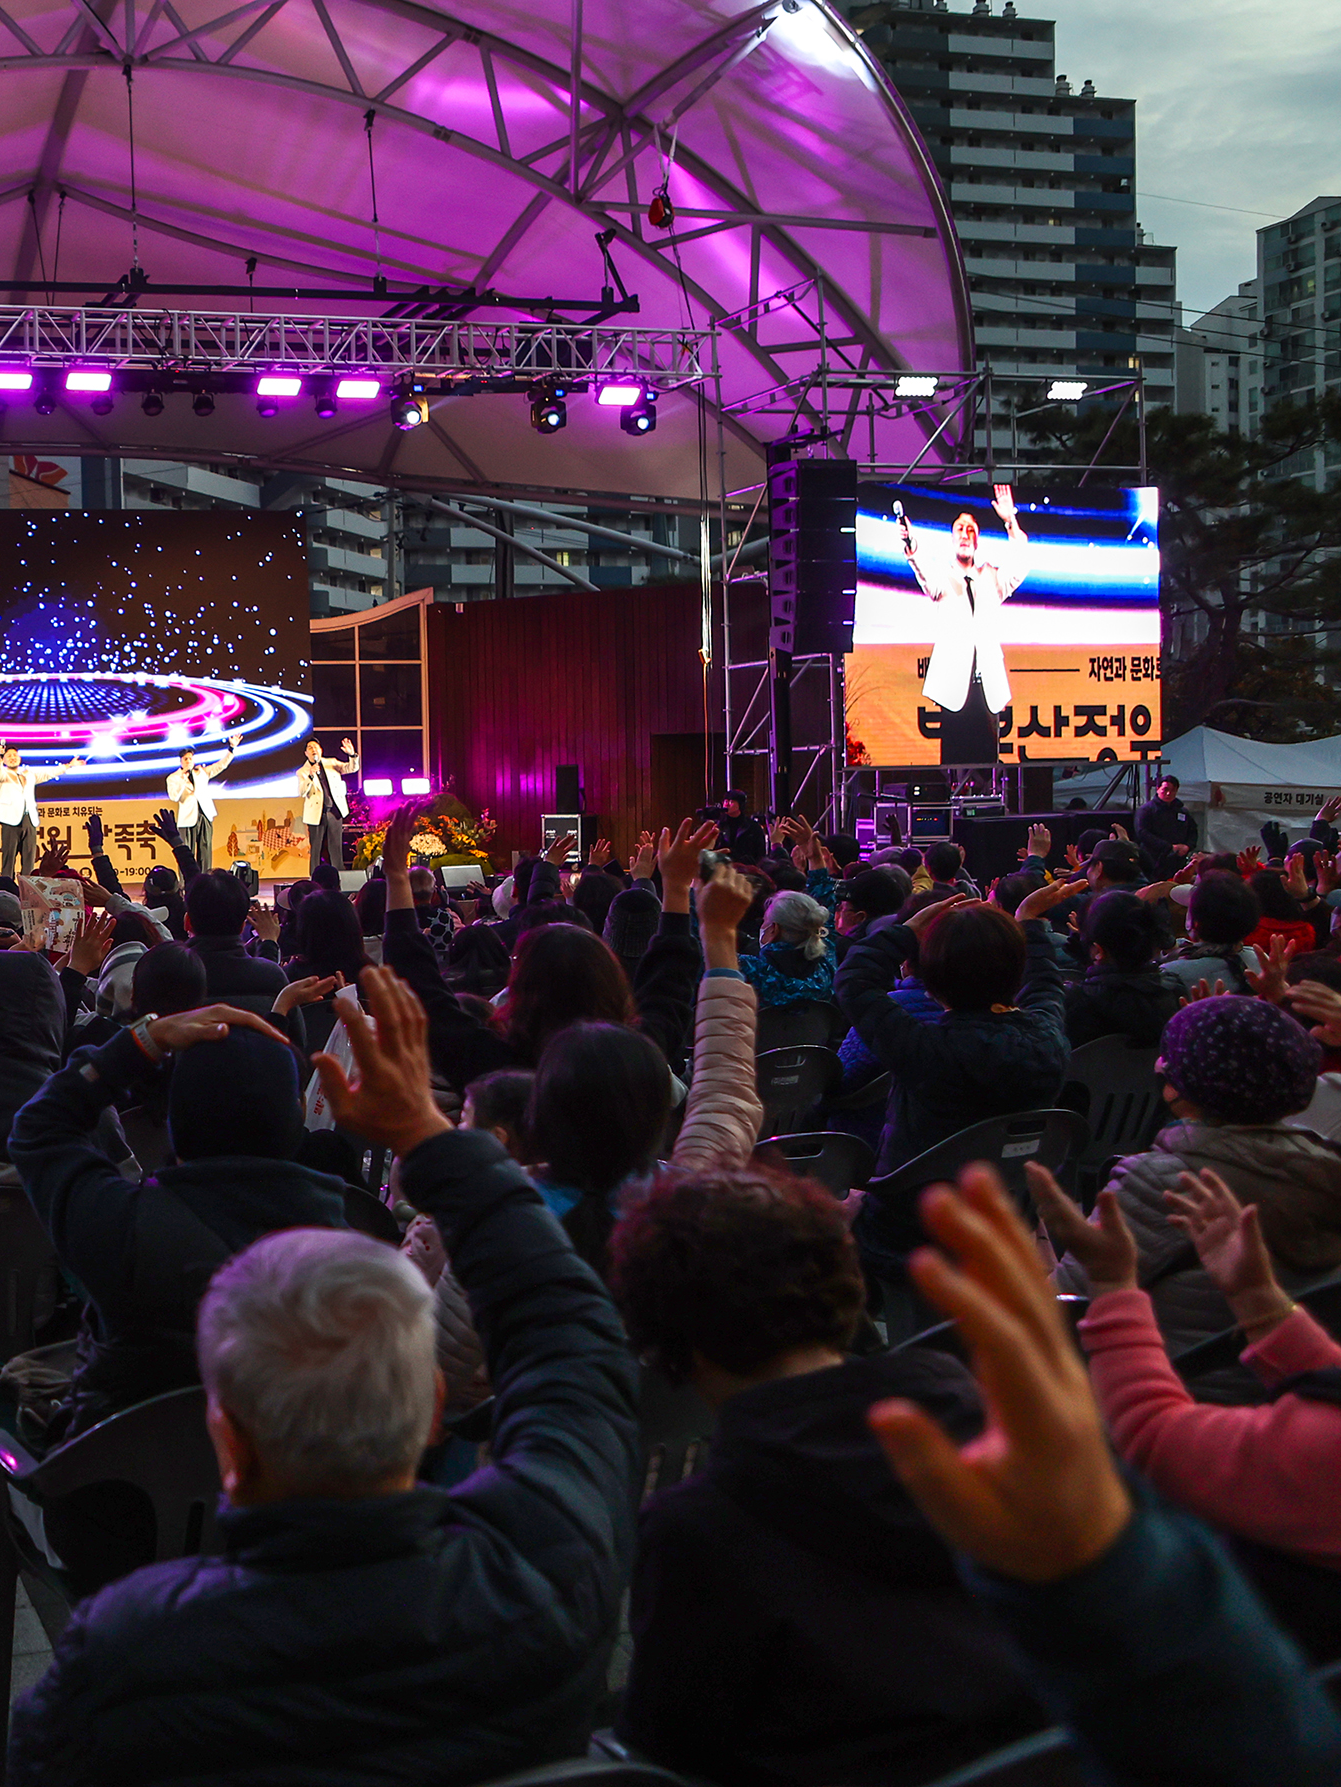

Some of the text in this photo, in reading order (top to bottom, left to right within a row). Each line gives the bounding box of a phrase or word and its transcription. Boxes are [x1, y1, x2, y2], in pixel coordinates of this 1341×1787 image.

[1088, 656, 1127, 682] 자연과
[1264, 792, 1324, 806] 공연자 대기실
[47, 807, 71, 818] 문화로
[72, 806, 103, 817] 치유되는
